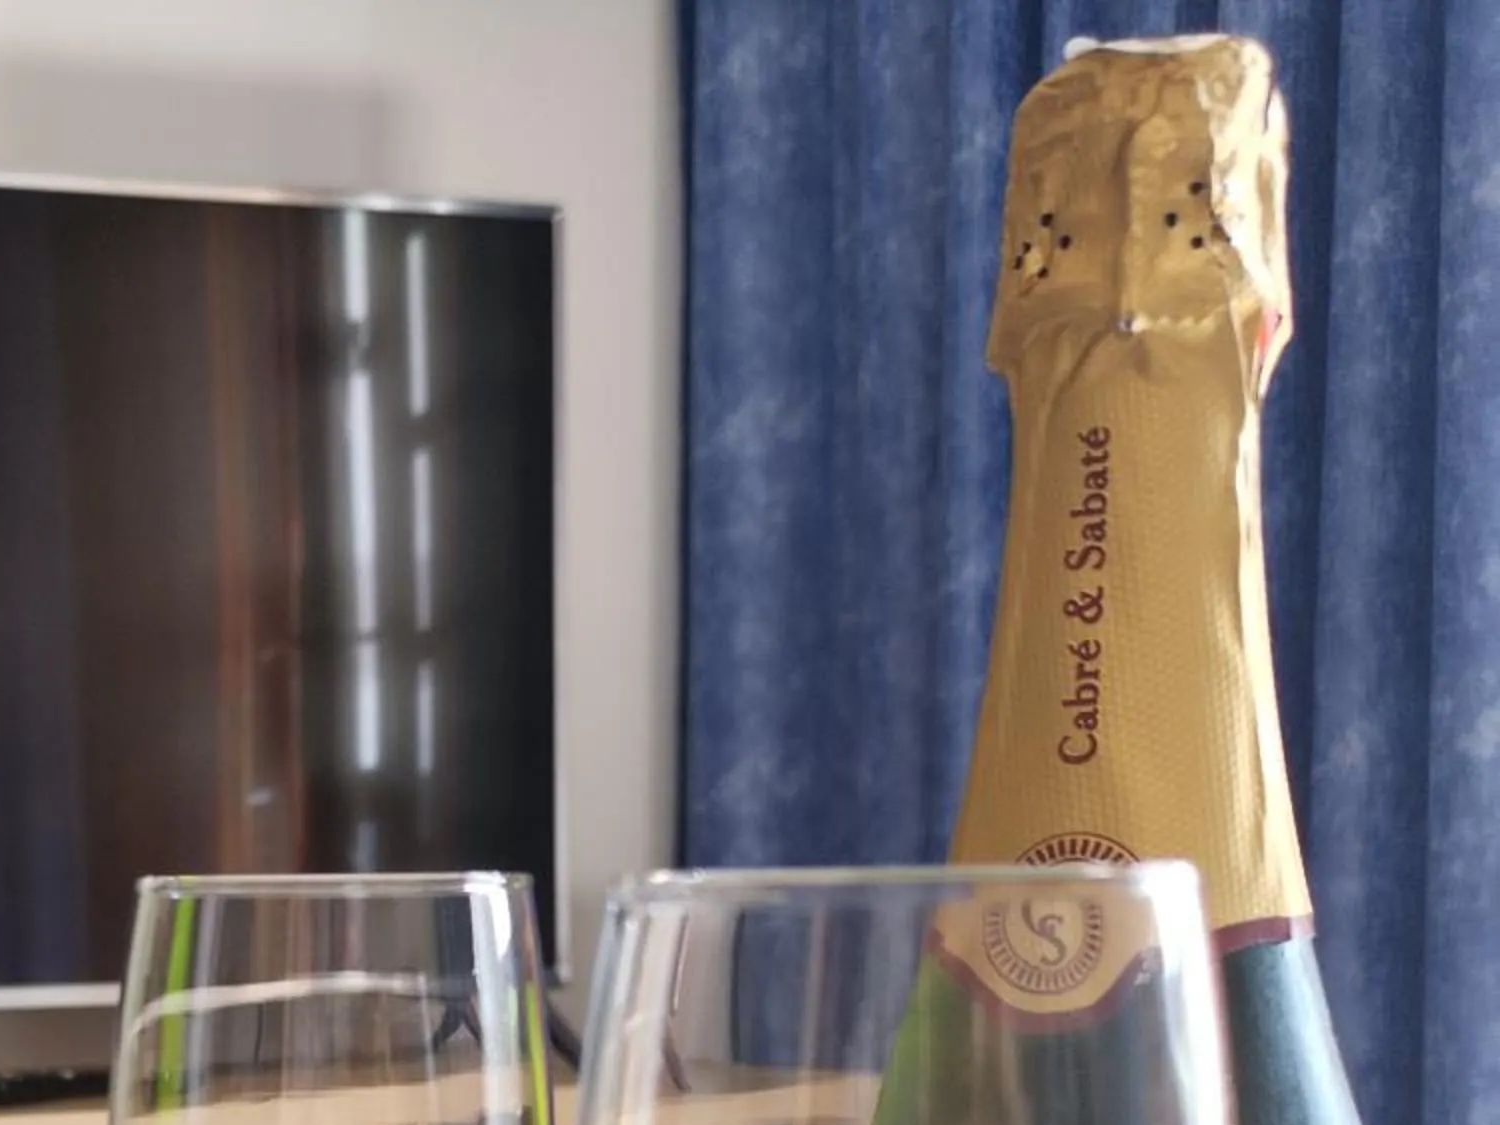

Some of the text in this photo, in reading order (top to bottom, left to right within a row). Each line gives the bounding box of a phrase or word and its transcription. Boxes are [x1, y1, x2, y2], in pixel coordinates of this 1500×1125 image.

[1057, 425, 1111, 765] Cabré & Sabaté
